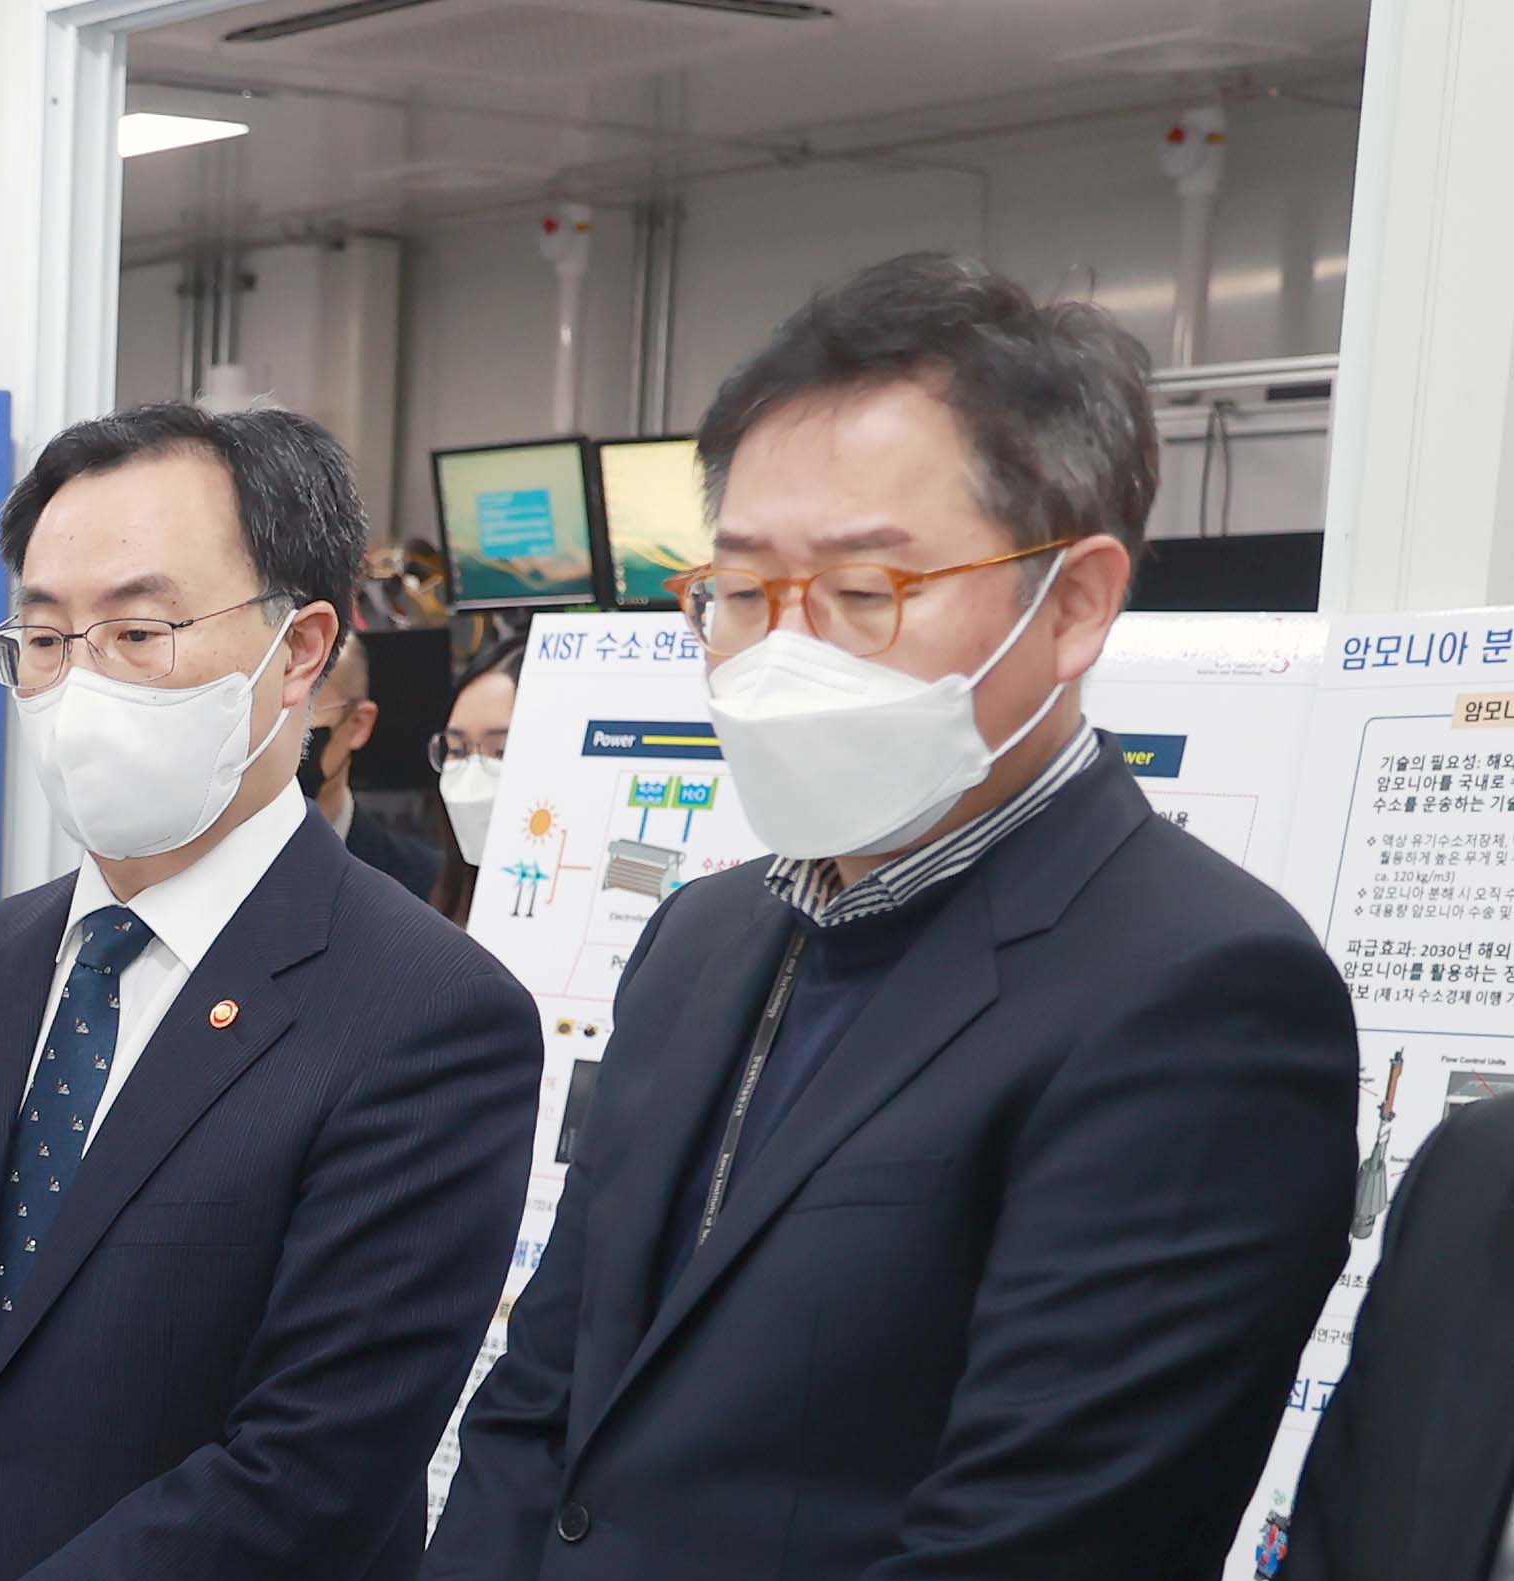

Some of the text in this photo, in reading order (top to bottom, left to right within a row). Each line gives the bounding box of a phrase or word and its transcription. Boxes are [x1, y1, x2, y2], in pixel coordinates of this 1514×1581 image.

[539, 632, 588, 661] KIST
[1343, 631, 1468, 671] 암모니아
[593, 731, 636, 747] Power
[1380, 755, 1425, 773] 기술의
[1377, 773, 1504, 793] 암모니아를 국내로
[1372, 796, 1417, 814] 수소를
[1423, 795, 1484, 813] 운송하는
[1394, 871, 1414, 882] 120
[1373, 886, 1424, 900] 암모니아
[1412, 904, 1463, 919] 암모니아
[1347, 940, 1511, 960] 파급효과: 2030년 해외
[1344, 962, 1423, 981] 암모니아를
[1431, 964, 1497, 982] 활용하는
